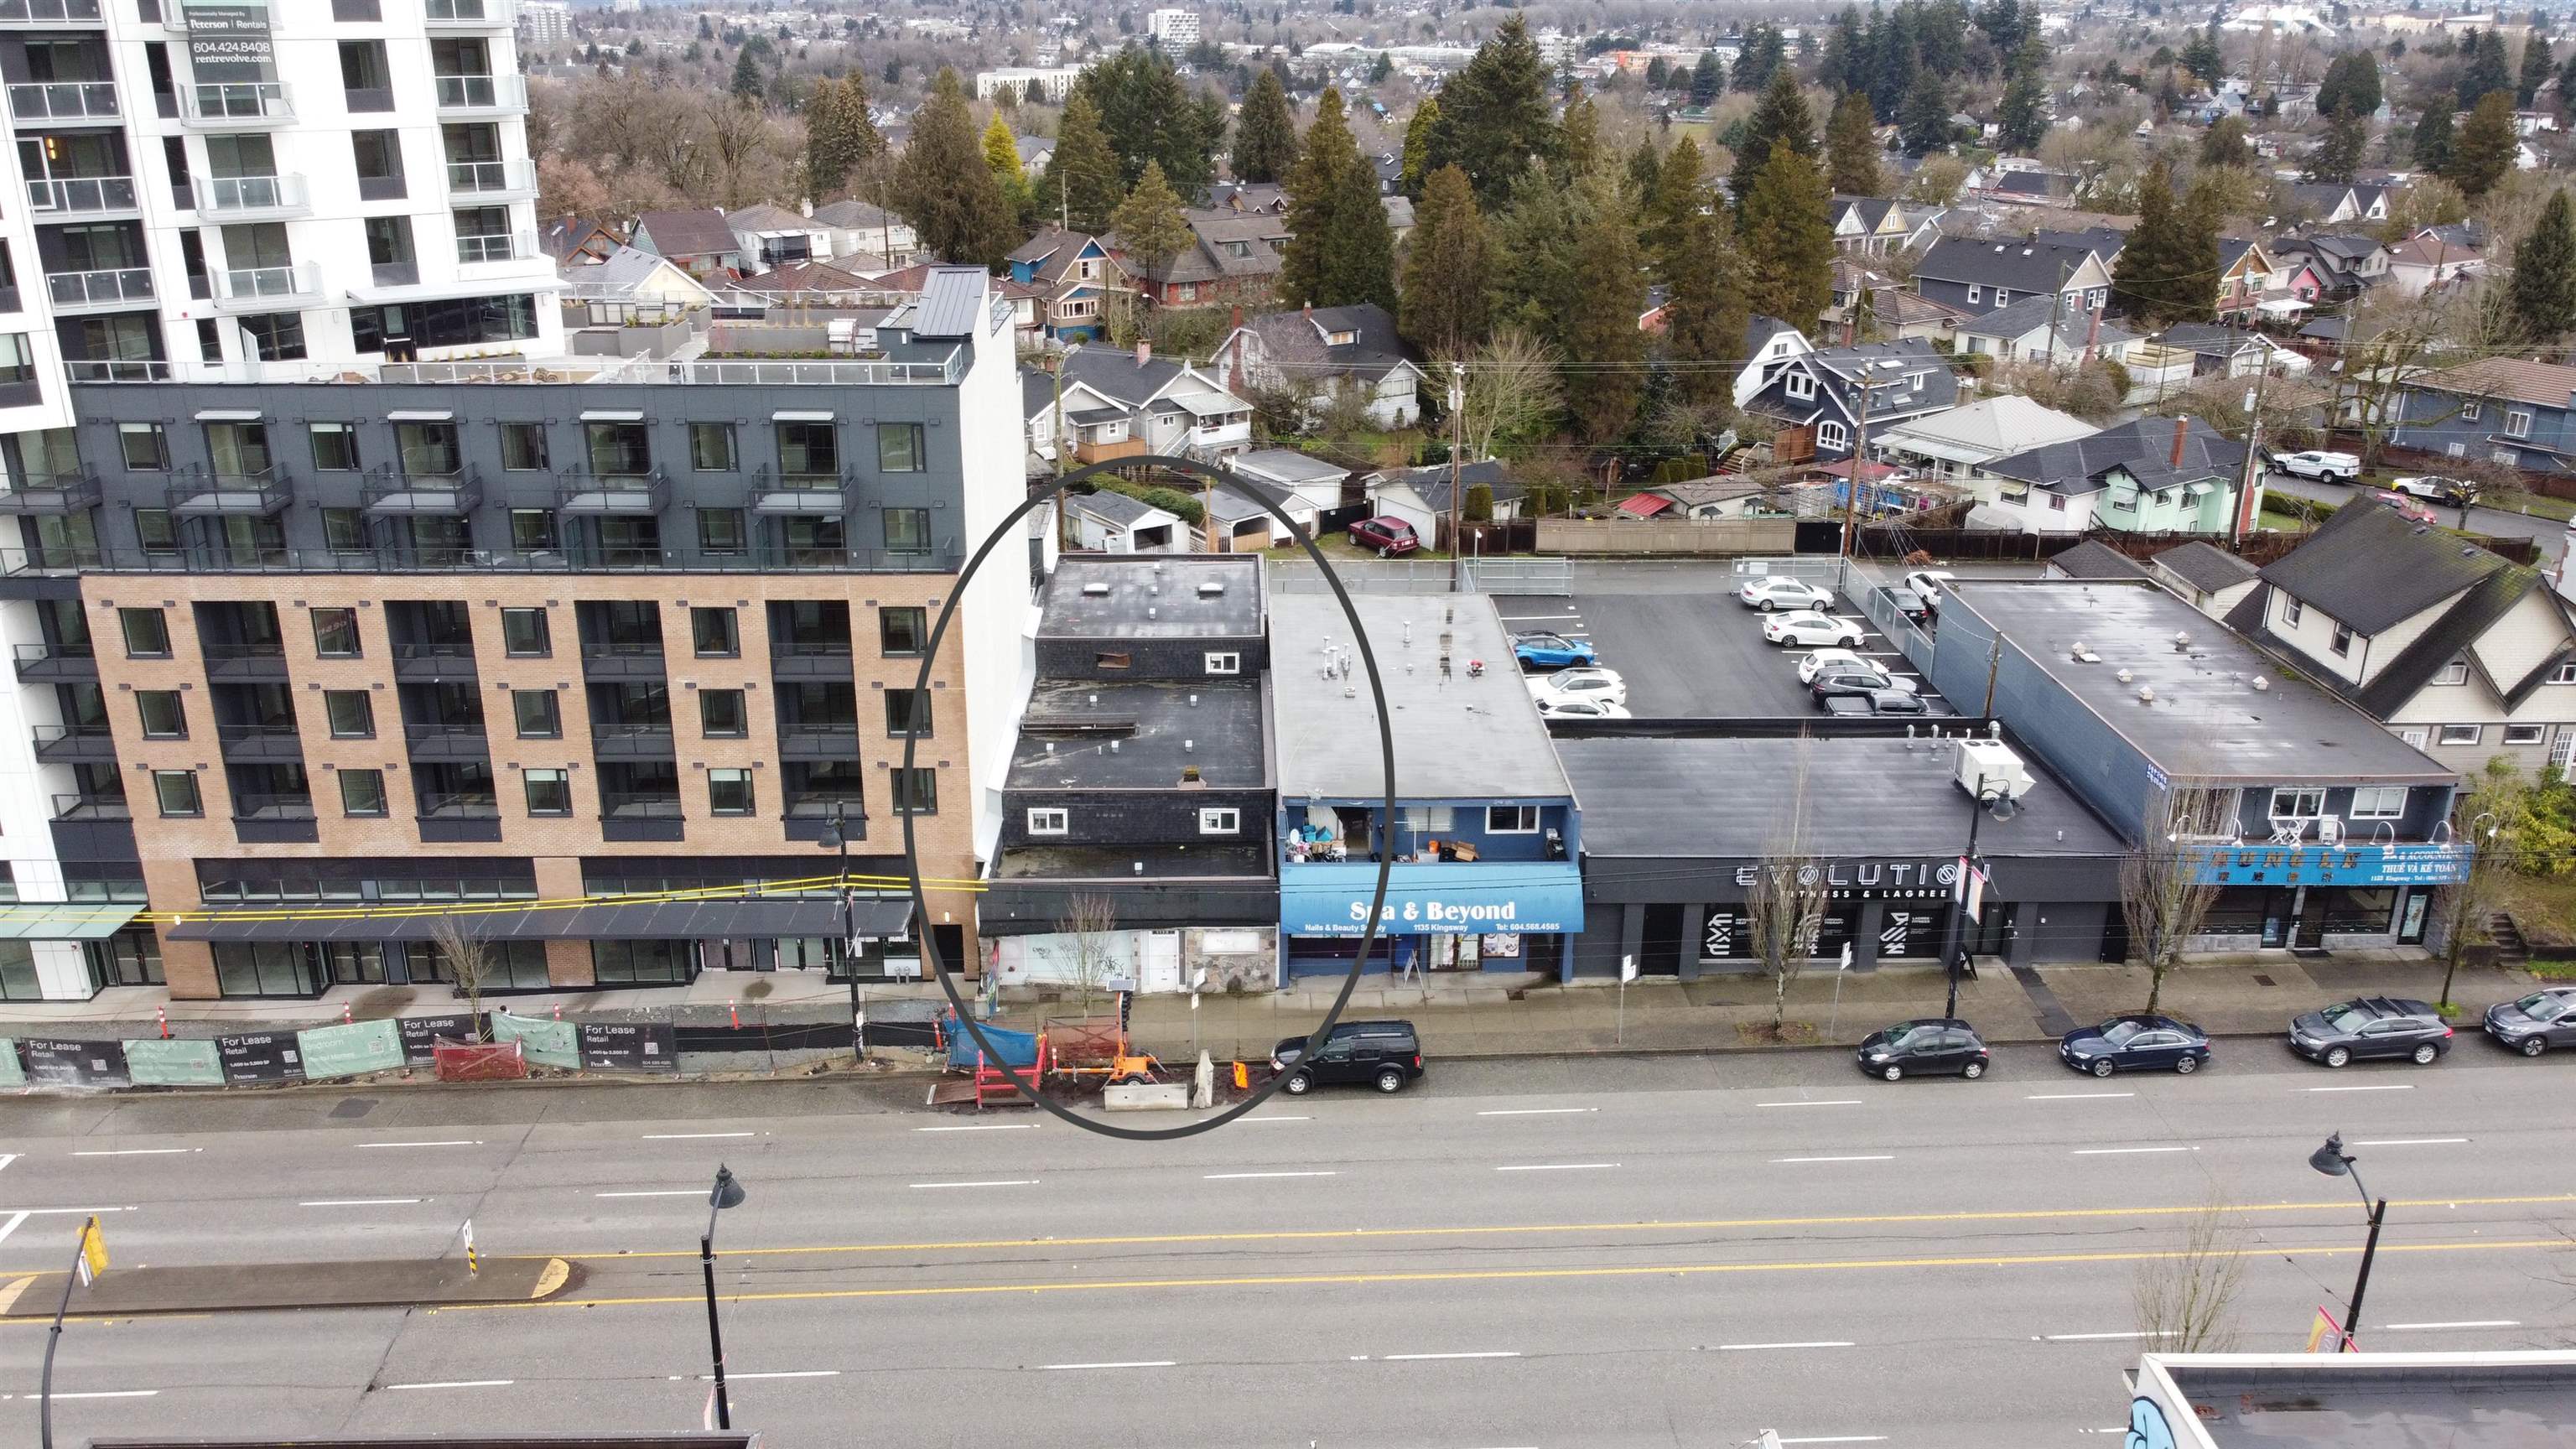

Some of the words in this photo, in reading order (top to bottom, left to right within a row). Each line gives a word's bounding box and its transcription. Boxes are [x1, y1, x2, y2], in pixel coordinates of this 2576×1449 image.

[190, 19, 229, 29] Peterson
[236, 20, 267, 29] Rentals
[194, 43, 270, 53] 604.424.8408
[195, 54, 272, 63] rentrevolve.com
[1736, 864, 1991, 886] EVOLUTIO
[1862, 890, 1871, 898] &
[1883, 889, 1947, 898] LAGREE
[1403, 901, 1420, 921] &
[1426, 901, 1515, 923] Beyond
[1332, 924, 1358, 932] Beauty
[1431, 924, 1468, 932] Kingsway
[403, 1021, 421, 1030] For
[424, 1019, 454, 1028] Lease
[406, 1030, 428, 1038] Retail
[585, 1026, 603, 1034] For
[605, 1026, 636, 1035] Lease
[222, 1037, 240, 1047] For
[242, 1036, 272, 1046] Lease
[587, 1035, 609, 1043] Retail
[29, 1040, 47, 1050] For
[49, 1041, 81, 1052] Lease
[31, 1050, 55, 1058] Retail
[225, 1047, 248, 1056] Retail
